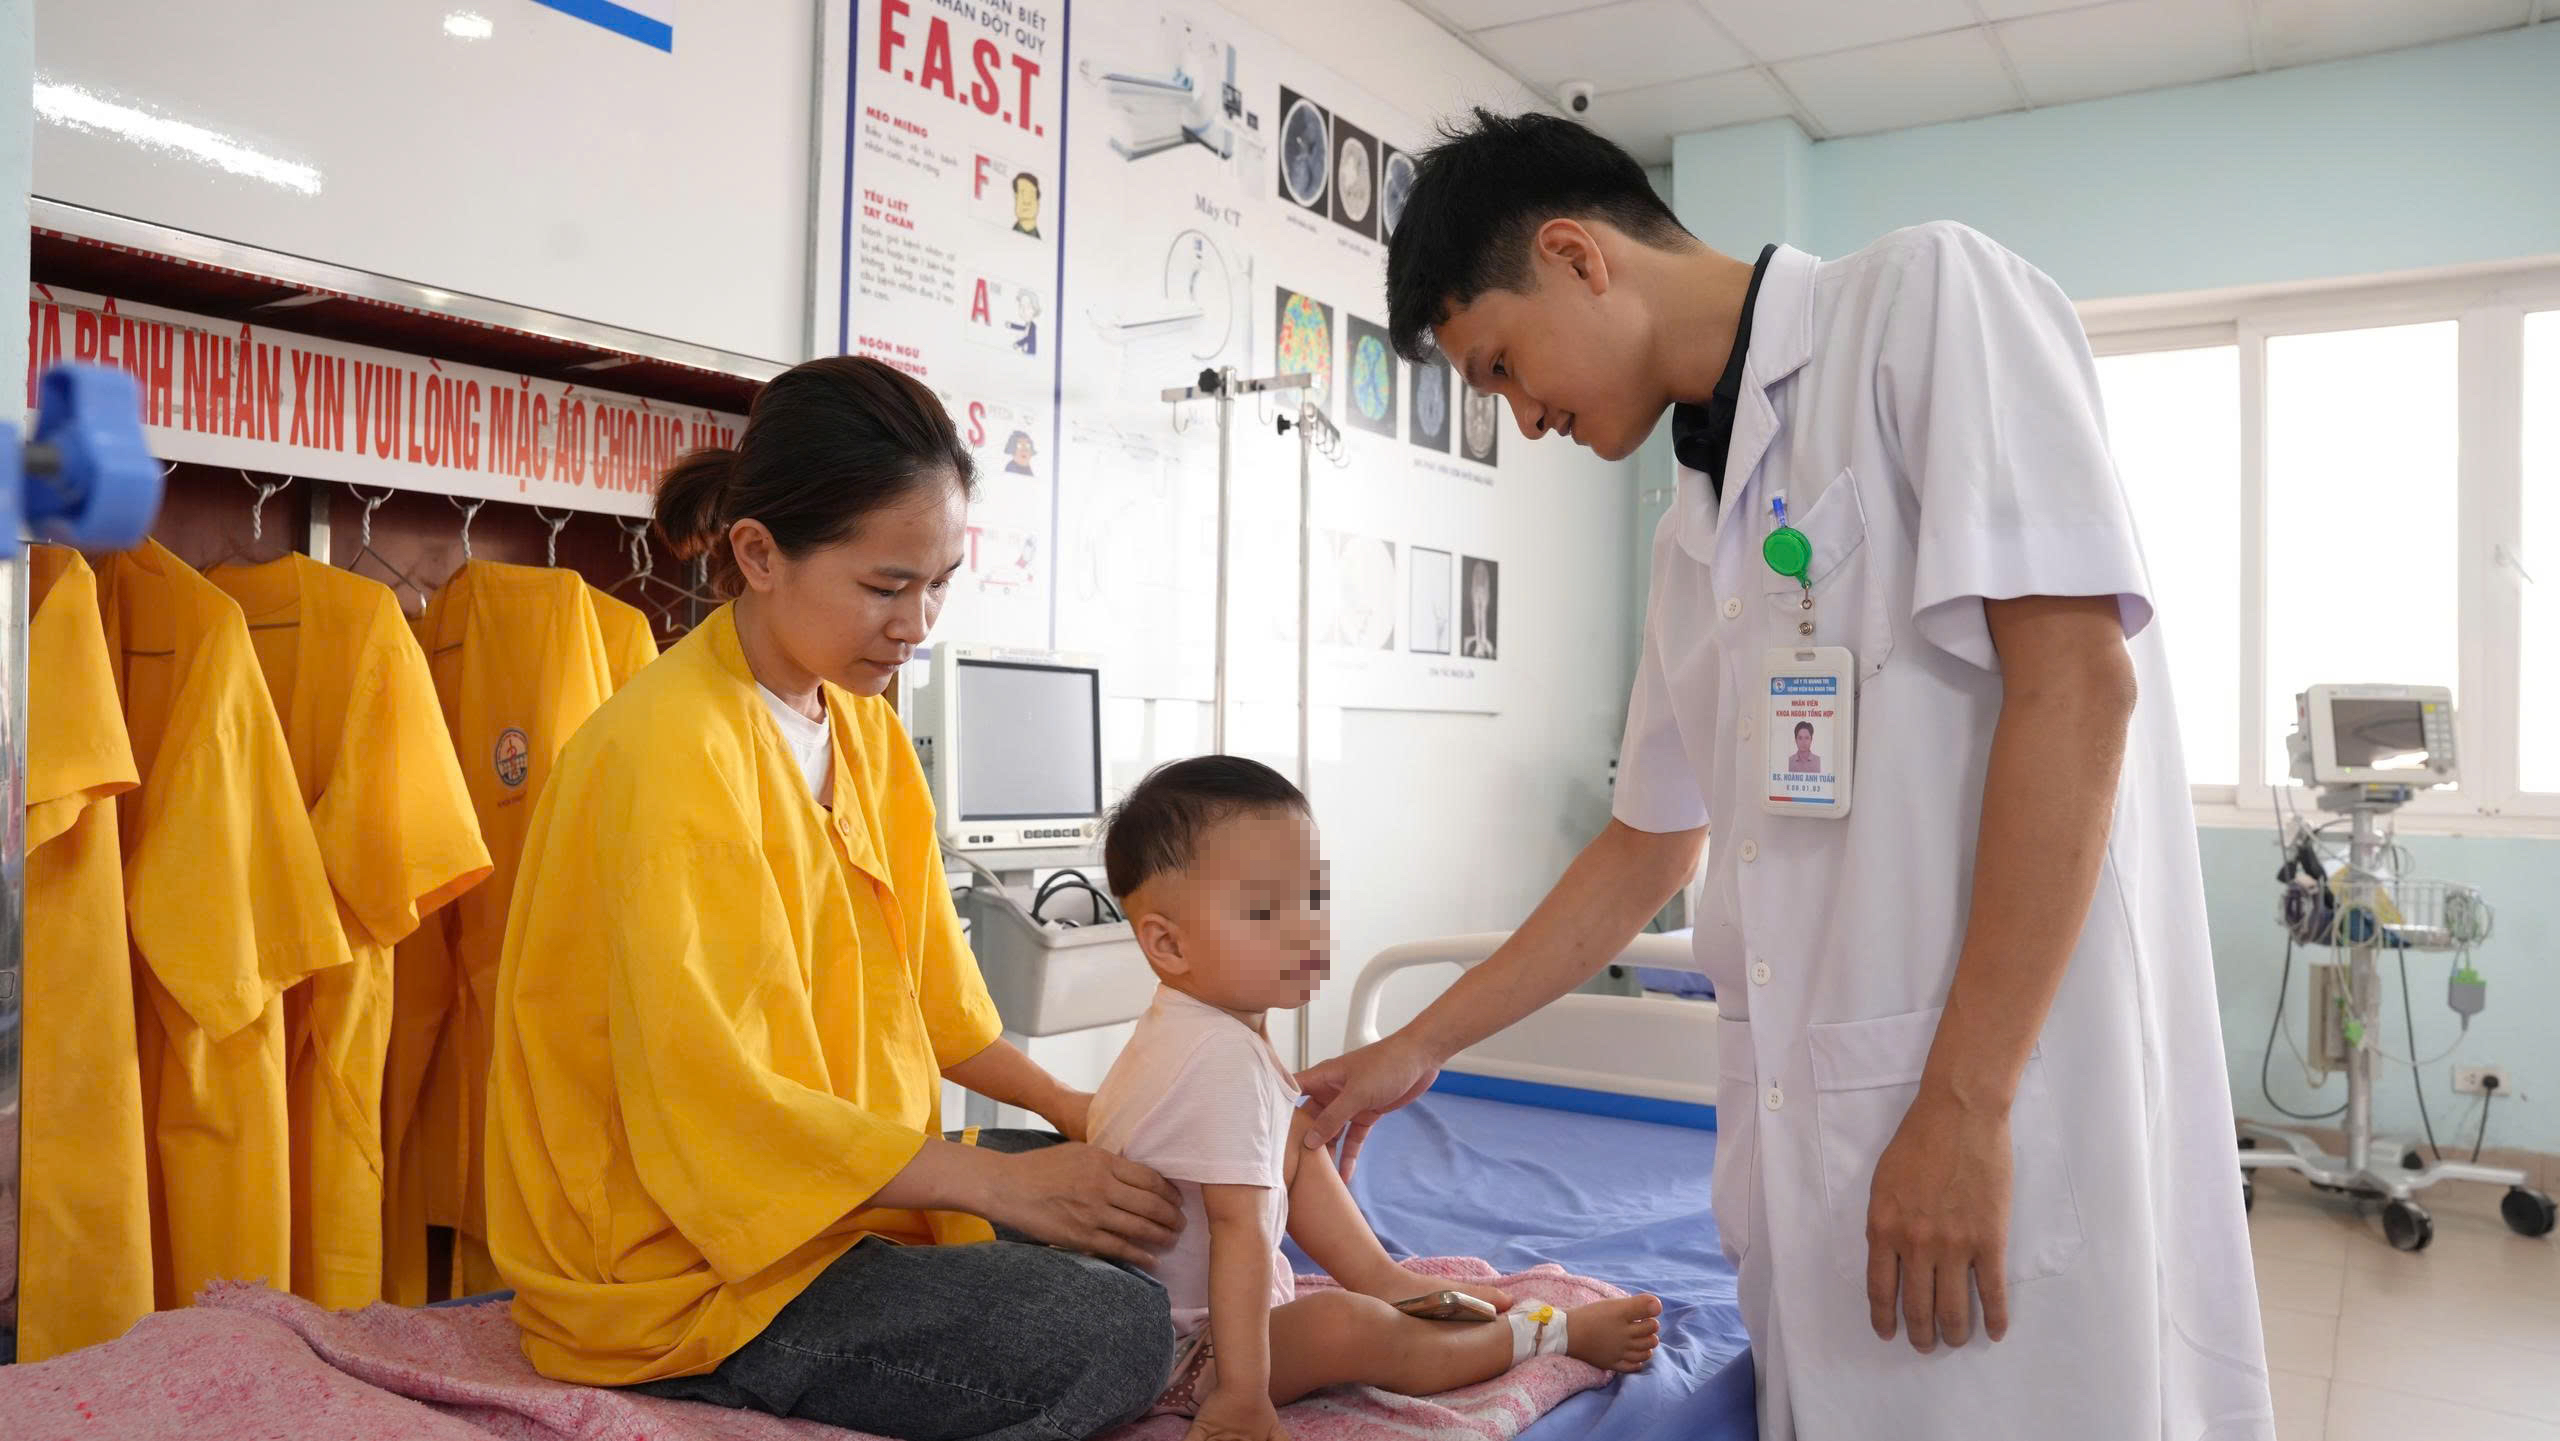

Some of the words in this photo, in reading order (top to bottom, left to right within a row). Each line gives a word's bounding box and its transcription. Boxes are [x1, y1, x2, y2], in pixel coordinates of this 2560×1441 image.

[879, 0, 1045, 138] F.A.S.T.
[974, 153, 991, 200] F
[1224, 208, 1242, 227] CT
[970, 277, 992, 327] A
[183, 322, 282, 443] NHÂN
[289, 348, 346, 452] XIN
[354, 360, 403, 461] VUI
[408, 357, 481, 472] LÒNG
[488, 375, 548, 493] MẶC
[553, 384, 587, 487] ÁO
[967, 401, 987, 448] S
[966, 527, 984, 573] T
[1805, 774, 1818, 782] ANH
